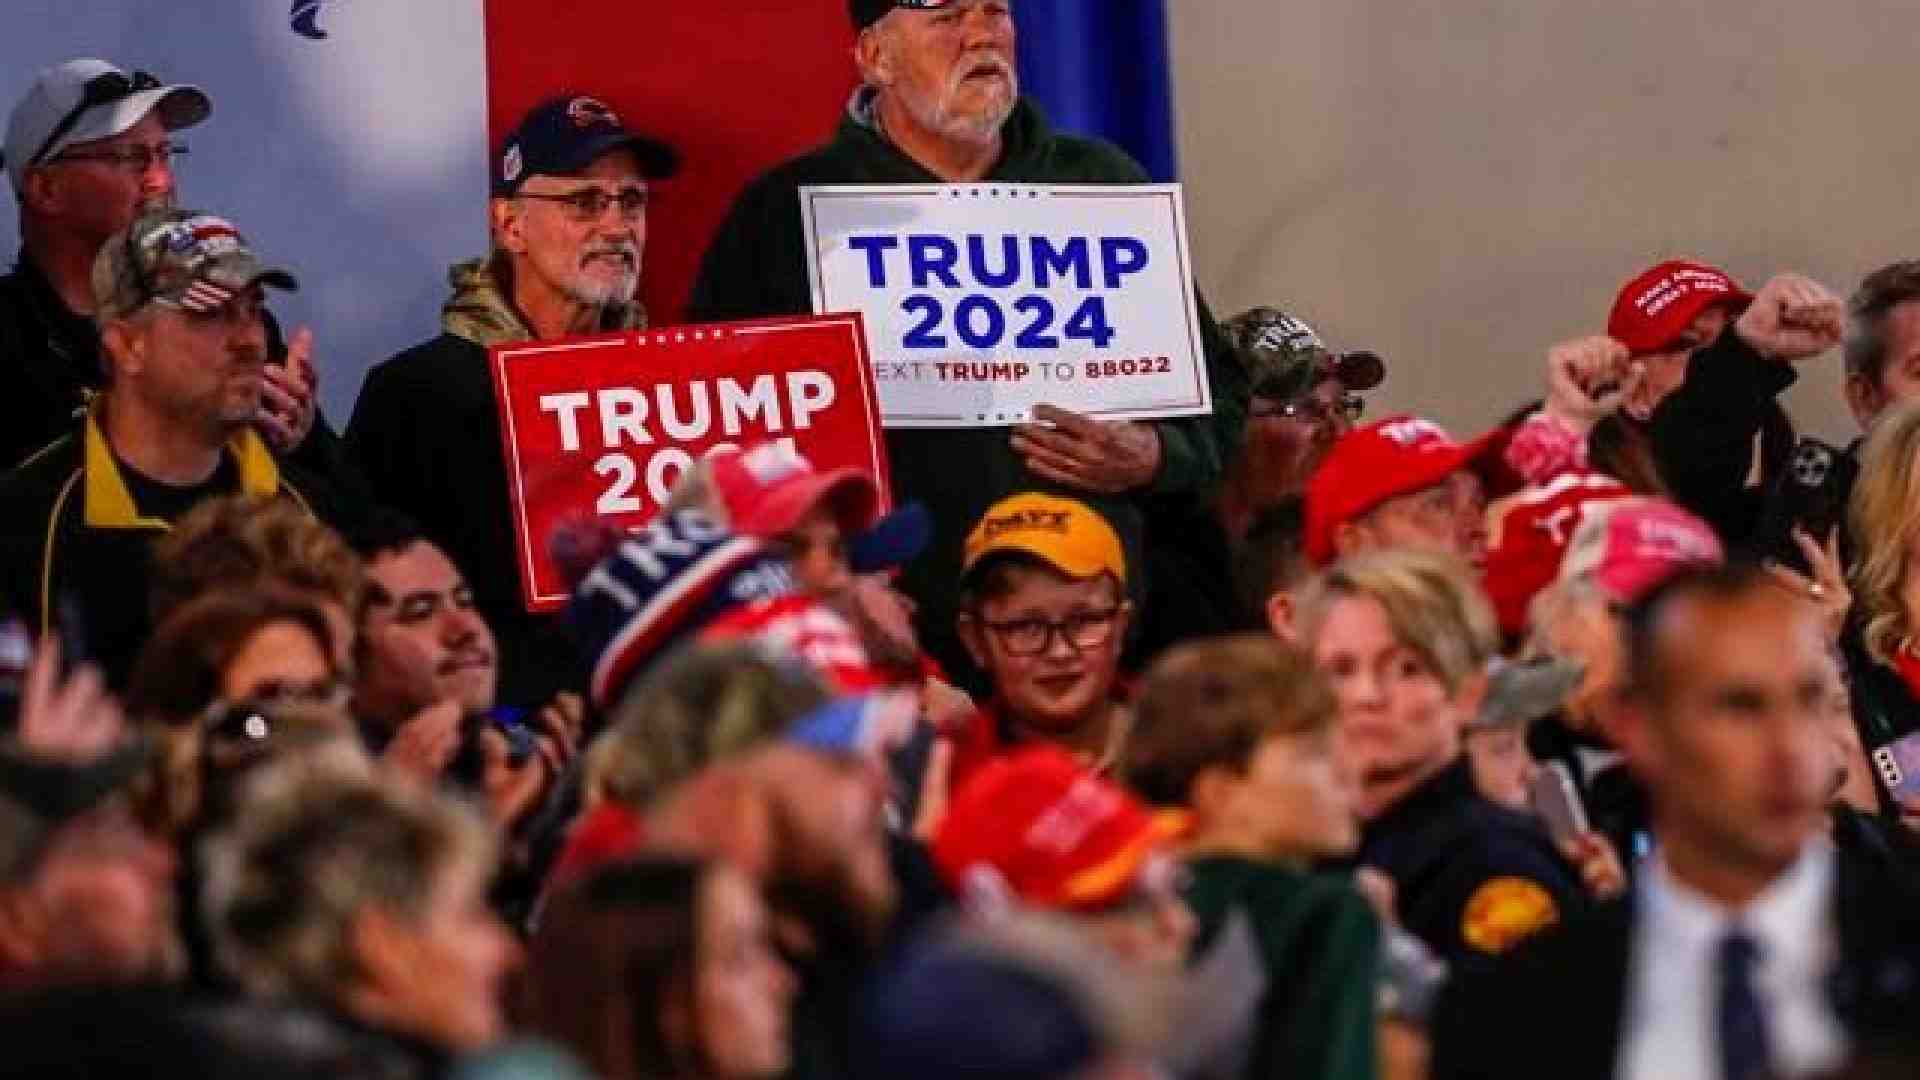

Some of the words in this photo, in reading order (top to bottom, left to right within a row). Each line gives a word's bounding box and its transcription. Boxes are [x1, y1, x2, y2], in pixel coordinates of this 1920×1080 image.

[849, 234, 1149, 288] TRUMP
[902, 294, 1114, 348] 2024
[874, 360, 928, 381] EXT
[935, 362, 1030, 382] TRUMP
[1039, 362, 1075, 381] TO
[1085, 356, 1171, 379] 88022
[540, 369, 836, 451] TRUMP
